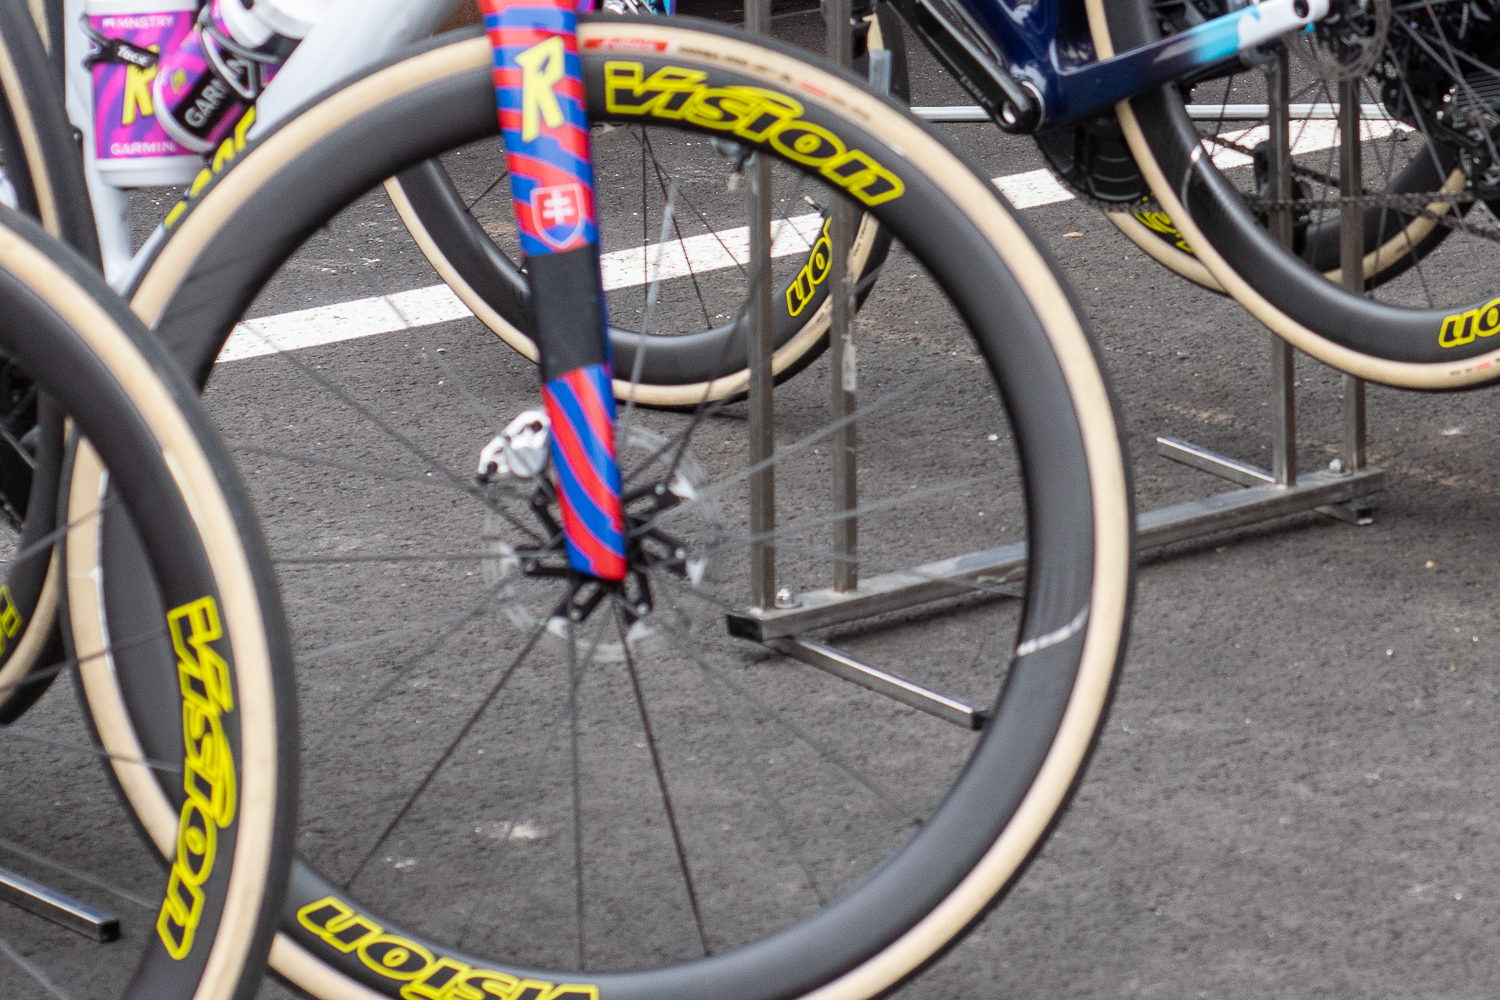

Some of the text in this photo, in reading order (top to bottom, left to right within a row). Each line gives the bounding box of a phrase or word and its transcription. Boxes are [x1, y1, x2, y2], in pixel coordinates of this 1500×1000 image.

[114, 15, 174, 28] MNSTRY
[117, 45, 150, 67] Tacx
[514, 35, 567, 144] R
[110, 140, 175, 156] GARMIN
[604, 61, 905, 206] Vision
[157, 595, 234, 960] Vision
